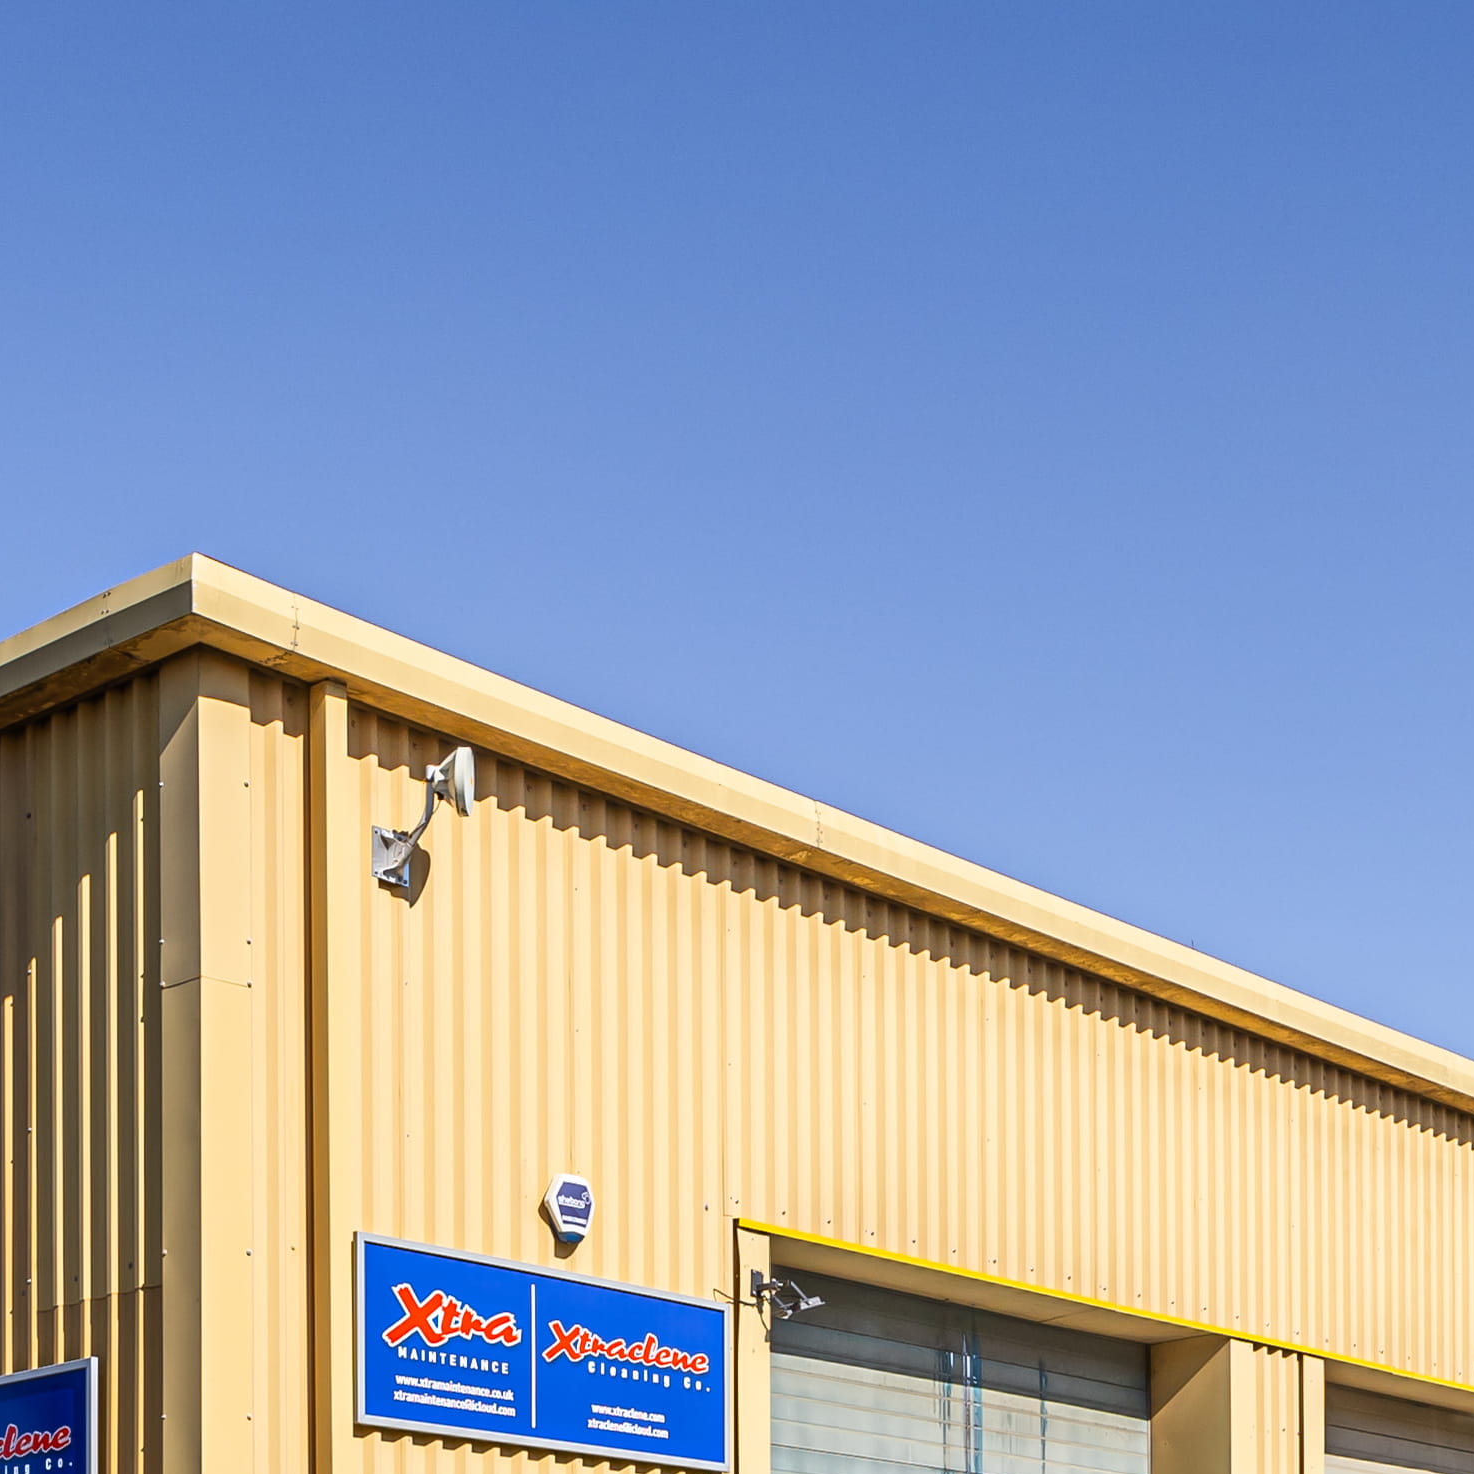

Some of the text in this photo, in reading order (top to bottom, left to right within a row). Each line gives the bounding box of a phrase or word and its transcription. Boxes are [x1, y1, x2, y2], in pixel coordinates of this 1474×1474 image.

[382, 1282, 522, 1348] Xtra
[398, 1346, 509, 1374] MAINTENANCE
[542, 1320, 709, 1374] Xtraclene
[395, 1375, 514, 1401] www.xtramaintenance.co.uk
[588, 1361, 711, 1392] Cleaning Co.
[45, 1457, 73, 1470] Co.
